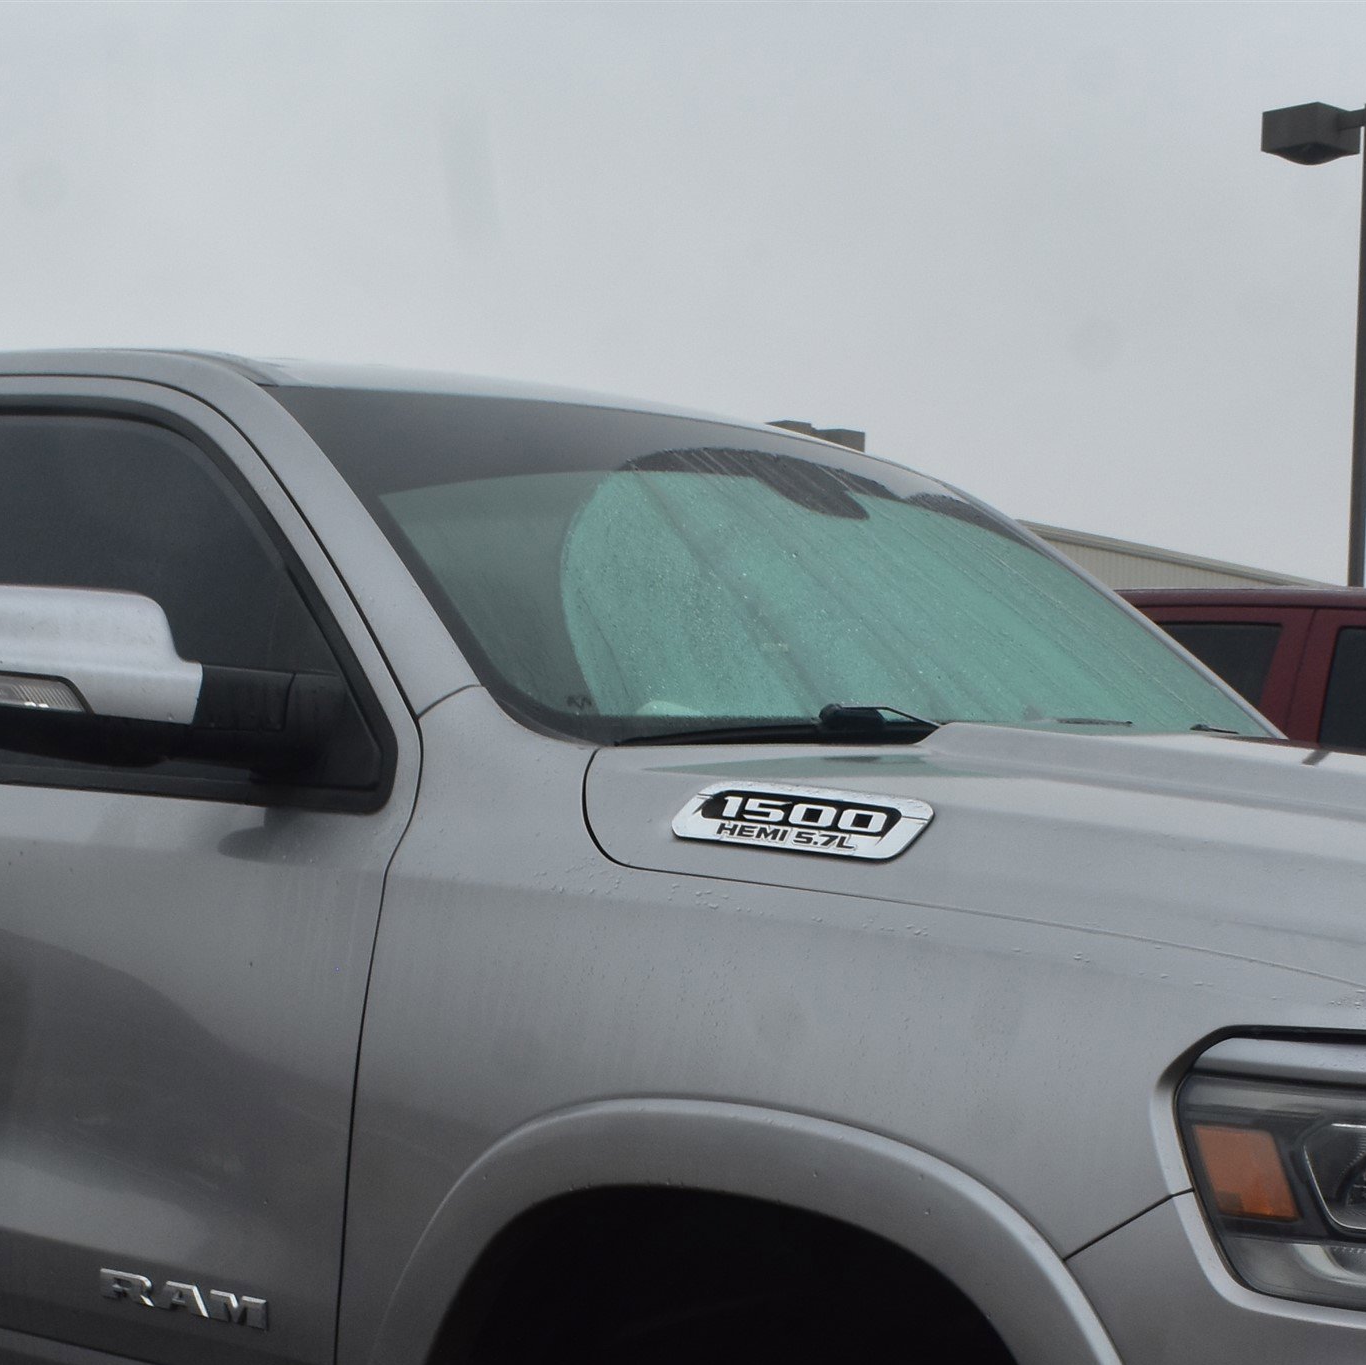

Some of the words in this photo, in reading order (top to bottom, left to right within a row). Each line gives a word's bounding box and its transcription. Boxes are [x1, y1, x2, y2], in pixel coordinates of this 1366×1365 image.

[721, 796, 887, 833] 1500
[716, 822, 788, 842] HEMI
[793, 831, 857, 851] 5.7L
[99, 1267, 270, 1331] RAM
